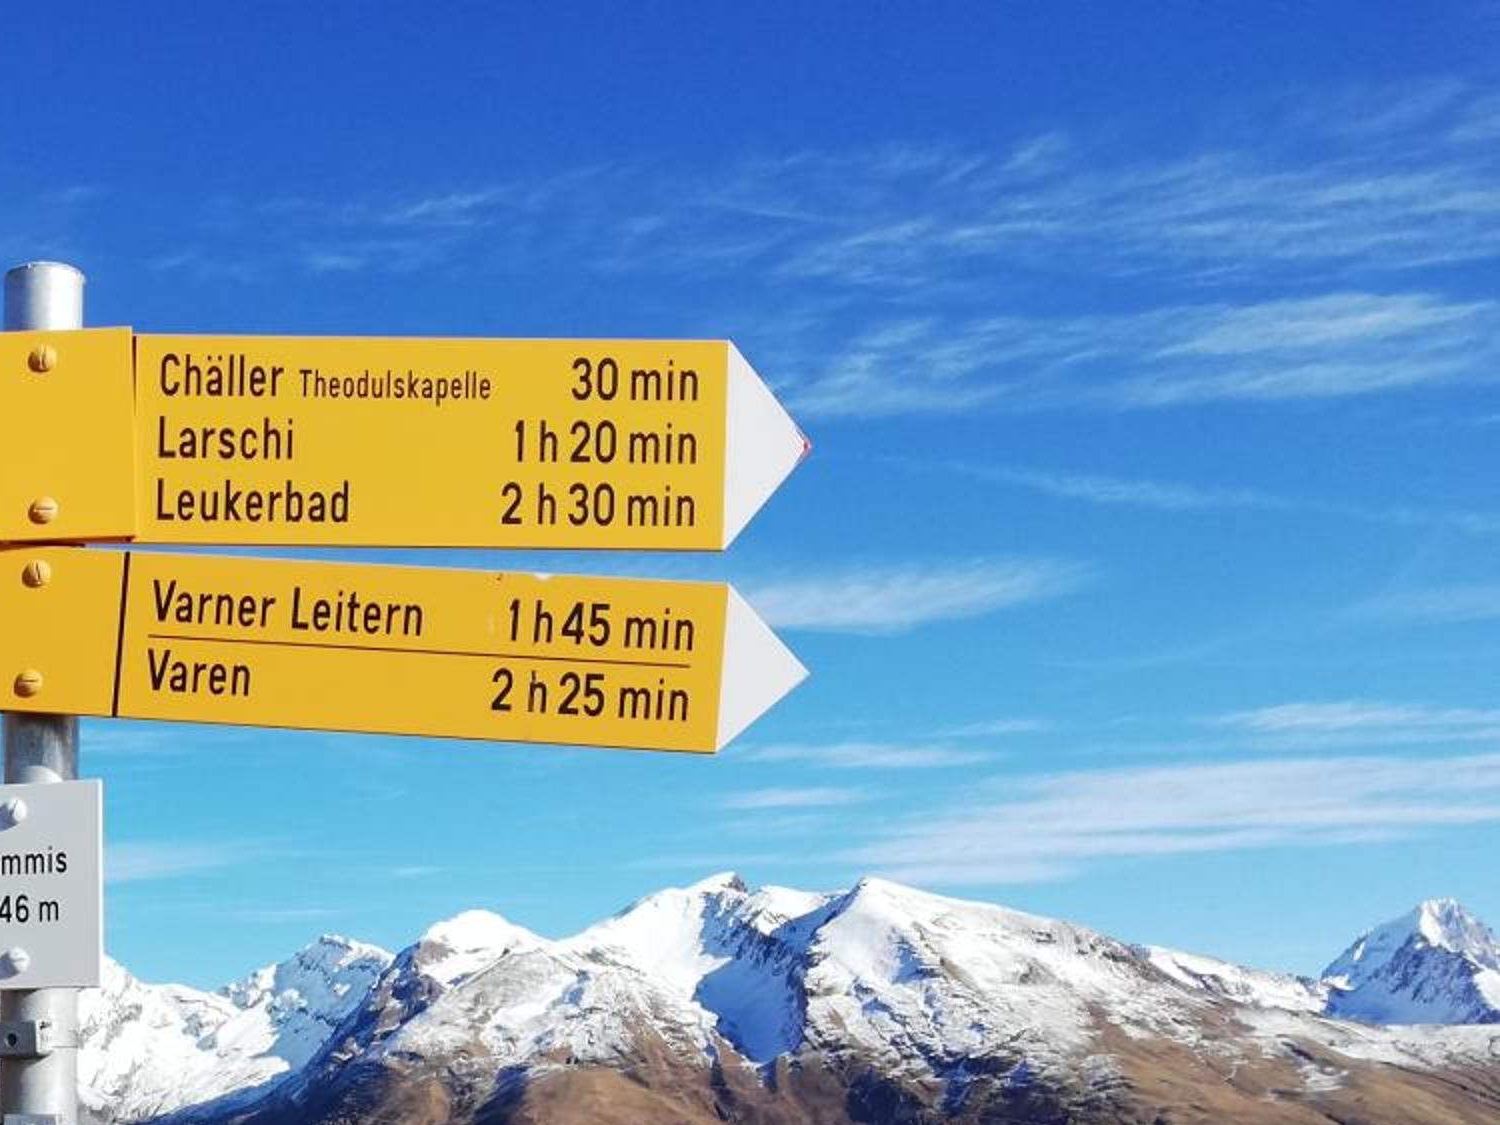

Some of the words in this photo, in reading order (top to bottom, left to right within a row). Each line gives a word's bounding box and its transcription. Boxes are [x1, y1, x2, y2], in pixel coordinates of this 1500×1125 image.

[160, 353, 285, 397] Chäller
[298, 368, 491, 407] Theodulskapelle
[571, 357, 619, 401] 30
[630, 359, 699, 401] min
[158, 415, 293, 460] Larschi
[515, 419, 525, 463] 1
[539, 419, 558, 463] h
[570, 419, 617, 464] 20
[628, 422, 697, 465] min
[157, 478, 349, 523] Leukerbad
[501, 481, 523, 525] 2
[537, 482, 557, 525] h
[567, 482, 615, 527] 30
[627, 485, 695, 527] min
[153, 579, 277, 628] Varner
[291, 586, 423, 637] Leitern
[509, 598, 520, 642] 1
[533, 599, 553, 644] h
[561, 602, 611, 647] 45
[623, 607, 694, 652] min
[147, 648, 251, 697] Varen
[491, 667, 514, 712] 2
[527, 670, 548, 714] h
[557, 671, 605, 717] 25
[618, 678, 689, 722] min
[38, 900, 59, 923] m
